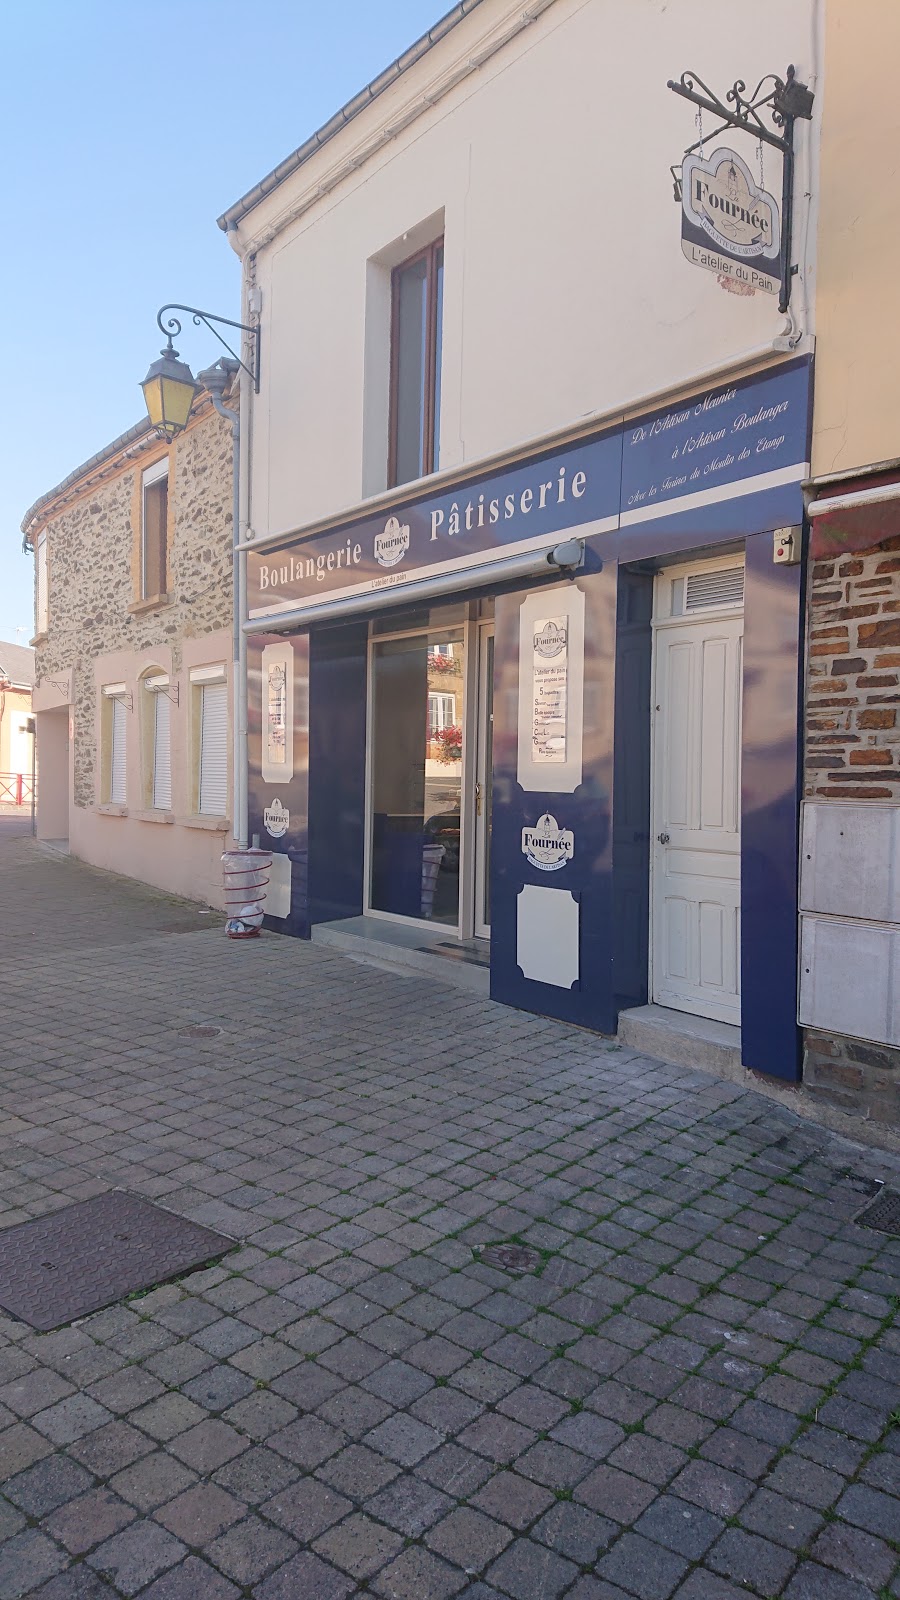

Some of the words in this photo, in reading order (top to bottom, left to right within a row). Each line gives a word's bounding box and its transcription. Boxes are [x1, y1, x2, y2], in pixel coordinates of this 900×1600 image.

[695, 180, 769, 233] Fournée
[702, 221, 730, 249] BAGUETTE
[691, 246, 733, 274] L'atelier
[736, 264, 749, 281] du
[751, 271, 773, 291] Pain
[631, 427, 647, 445] De
[649, 410, 690, 437] l'Artisan
[694, 388, 737, 416] Meunier
[671, 445, 679, 459] à
[682, 428, 727, 455] l'Artisan
[731, 400, 789, 433] Boulanger
[628, 491, 647, 505] Avec
[648, 485, 657, 496] les
[661, 475, 687, 492] Farines
[690, 467, 701, 479] du
[703, 454, 735, 475] Moulin
[738, 446, 751, 461] des
[429, 466, 587, 541] Pâtisserie
[259, 538, 362, 591] Boulangerie
[376, 533, 408, 551] Fournée
[371, 577, 389, 588] L'atelier
[390, 575, 396, 584] du
[396, 572, 407, 584] pain
[539, 686, 544, 696] 5
[524, 833, 572, 851] Fournée
